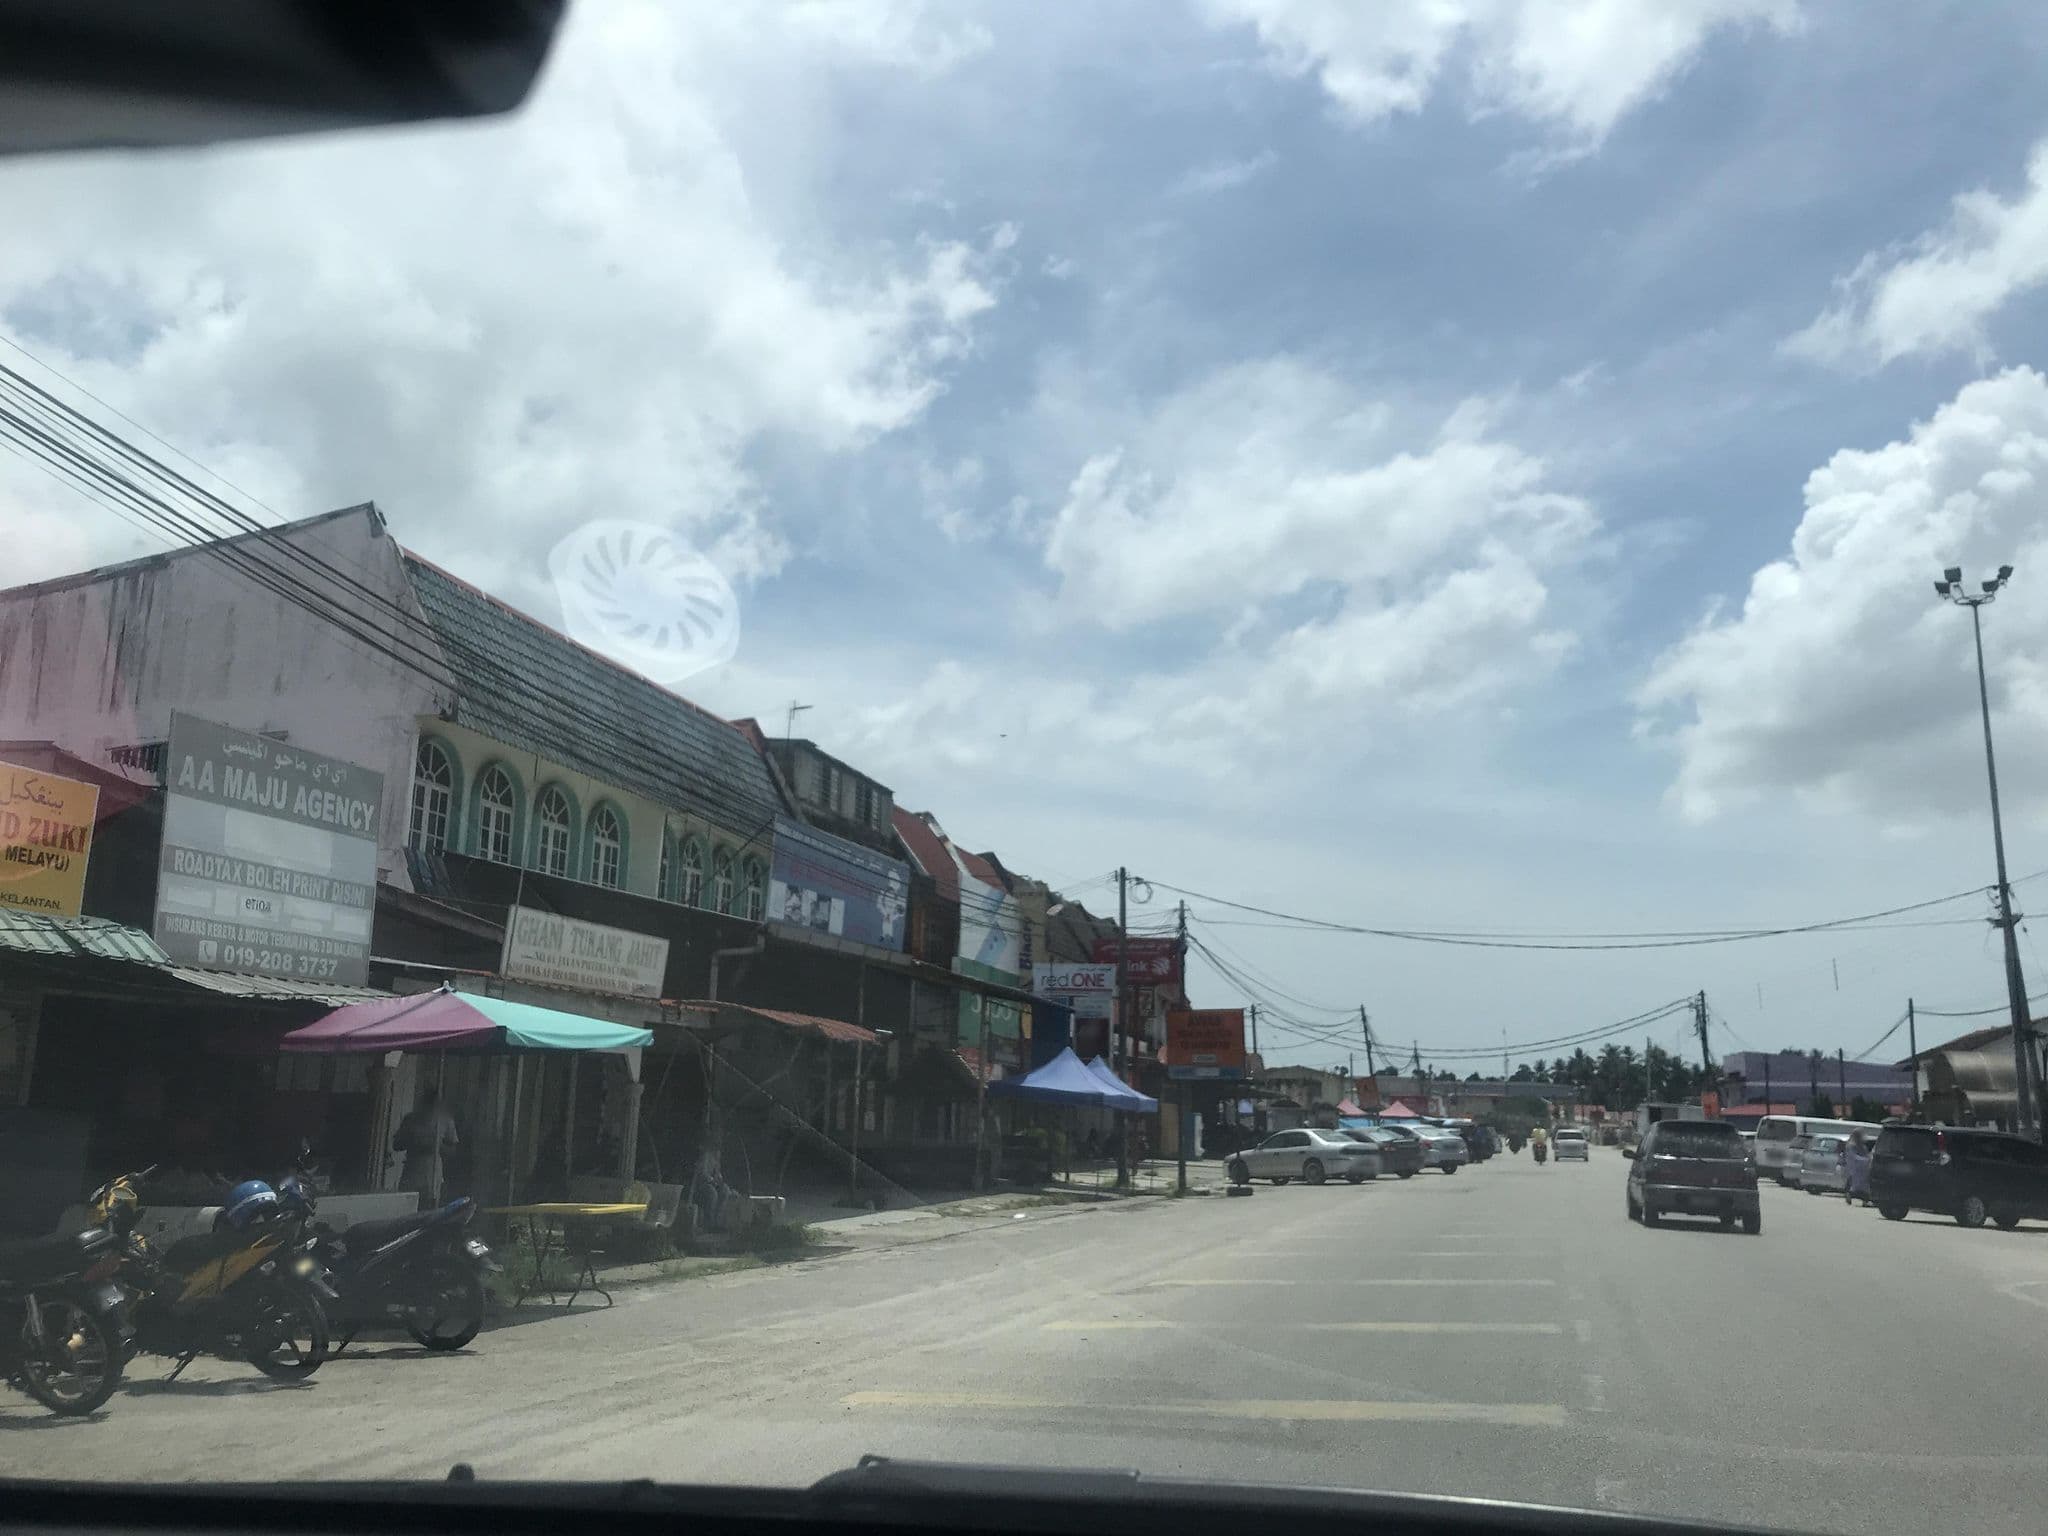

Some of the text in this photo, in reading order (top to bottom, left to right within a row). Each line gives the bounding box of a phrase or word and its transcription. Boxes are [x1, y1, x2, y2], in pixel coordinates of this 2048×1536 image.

[178, 755, 374, 831] AA MAJU AGENCY
[27, 816, 88, 854] ZUKI
[5, 844, 70, 873] MELAYU)
[174, 849, 242, 882] ROADTAX
[246, 864, 293, 894] BOLEH
[293, 875, 330, 900] PRINT
[517, 916, 565, 950] GHANI
[224, 945, 338, 977] 019-208 3737
